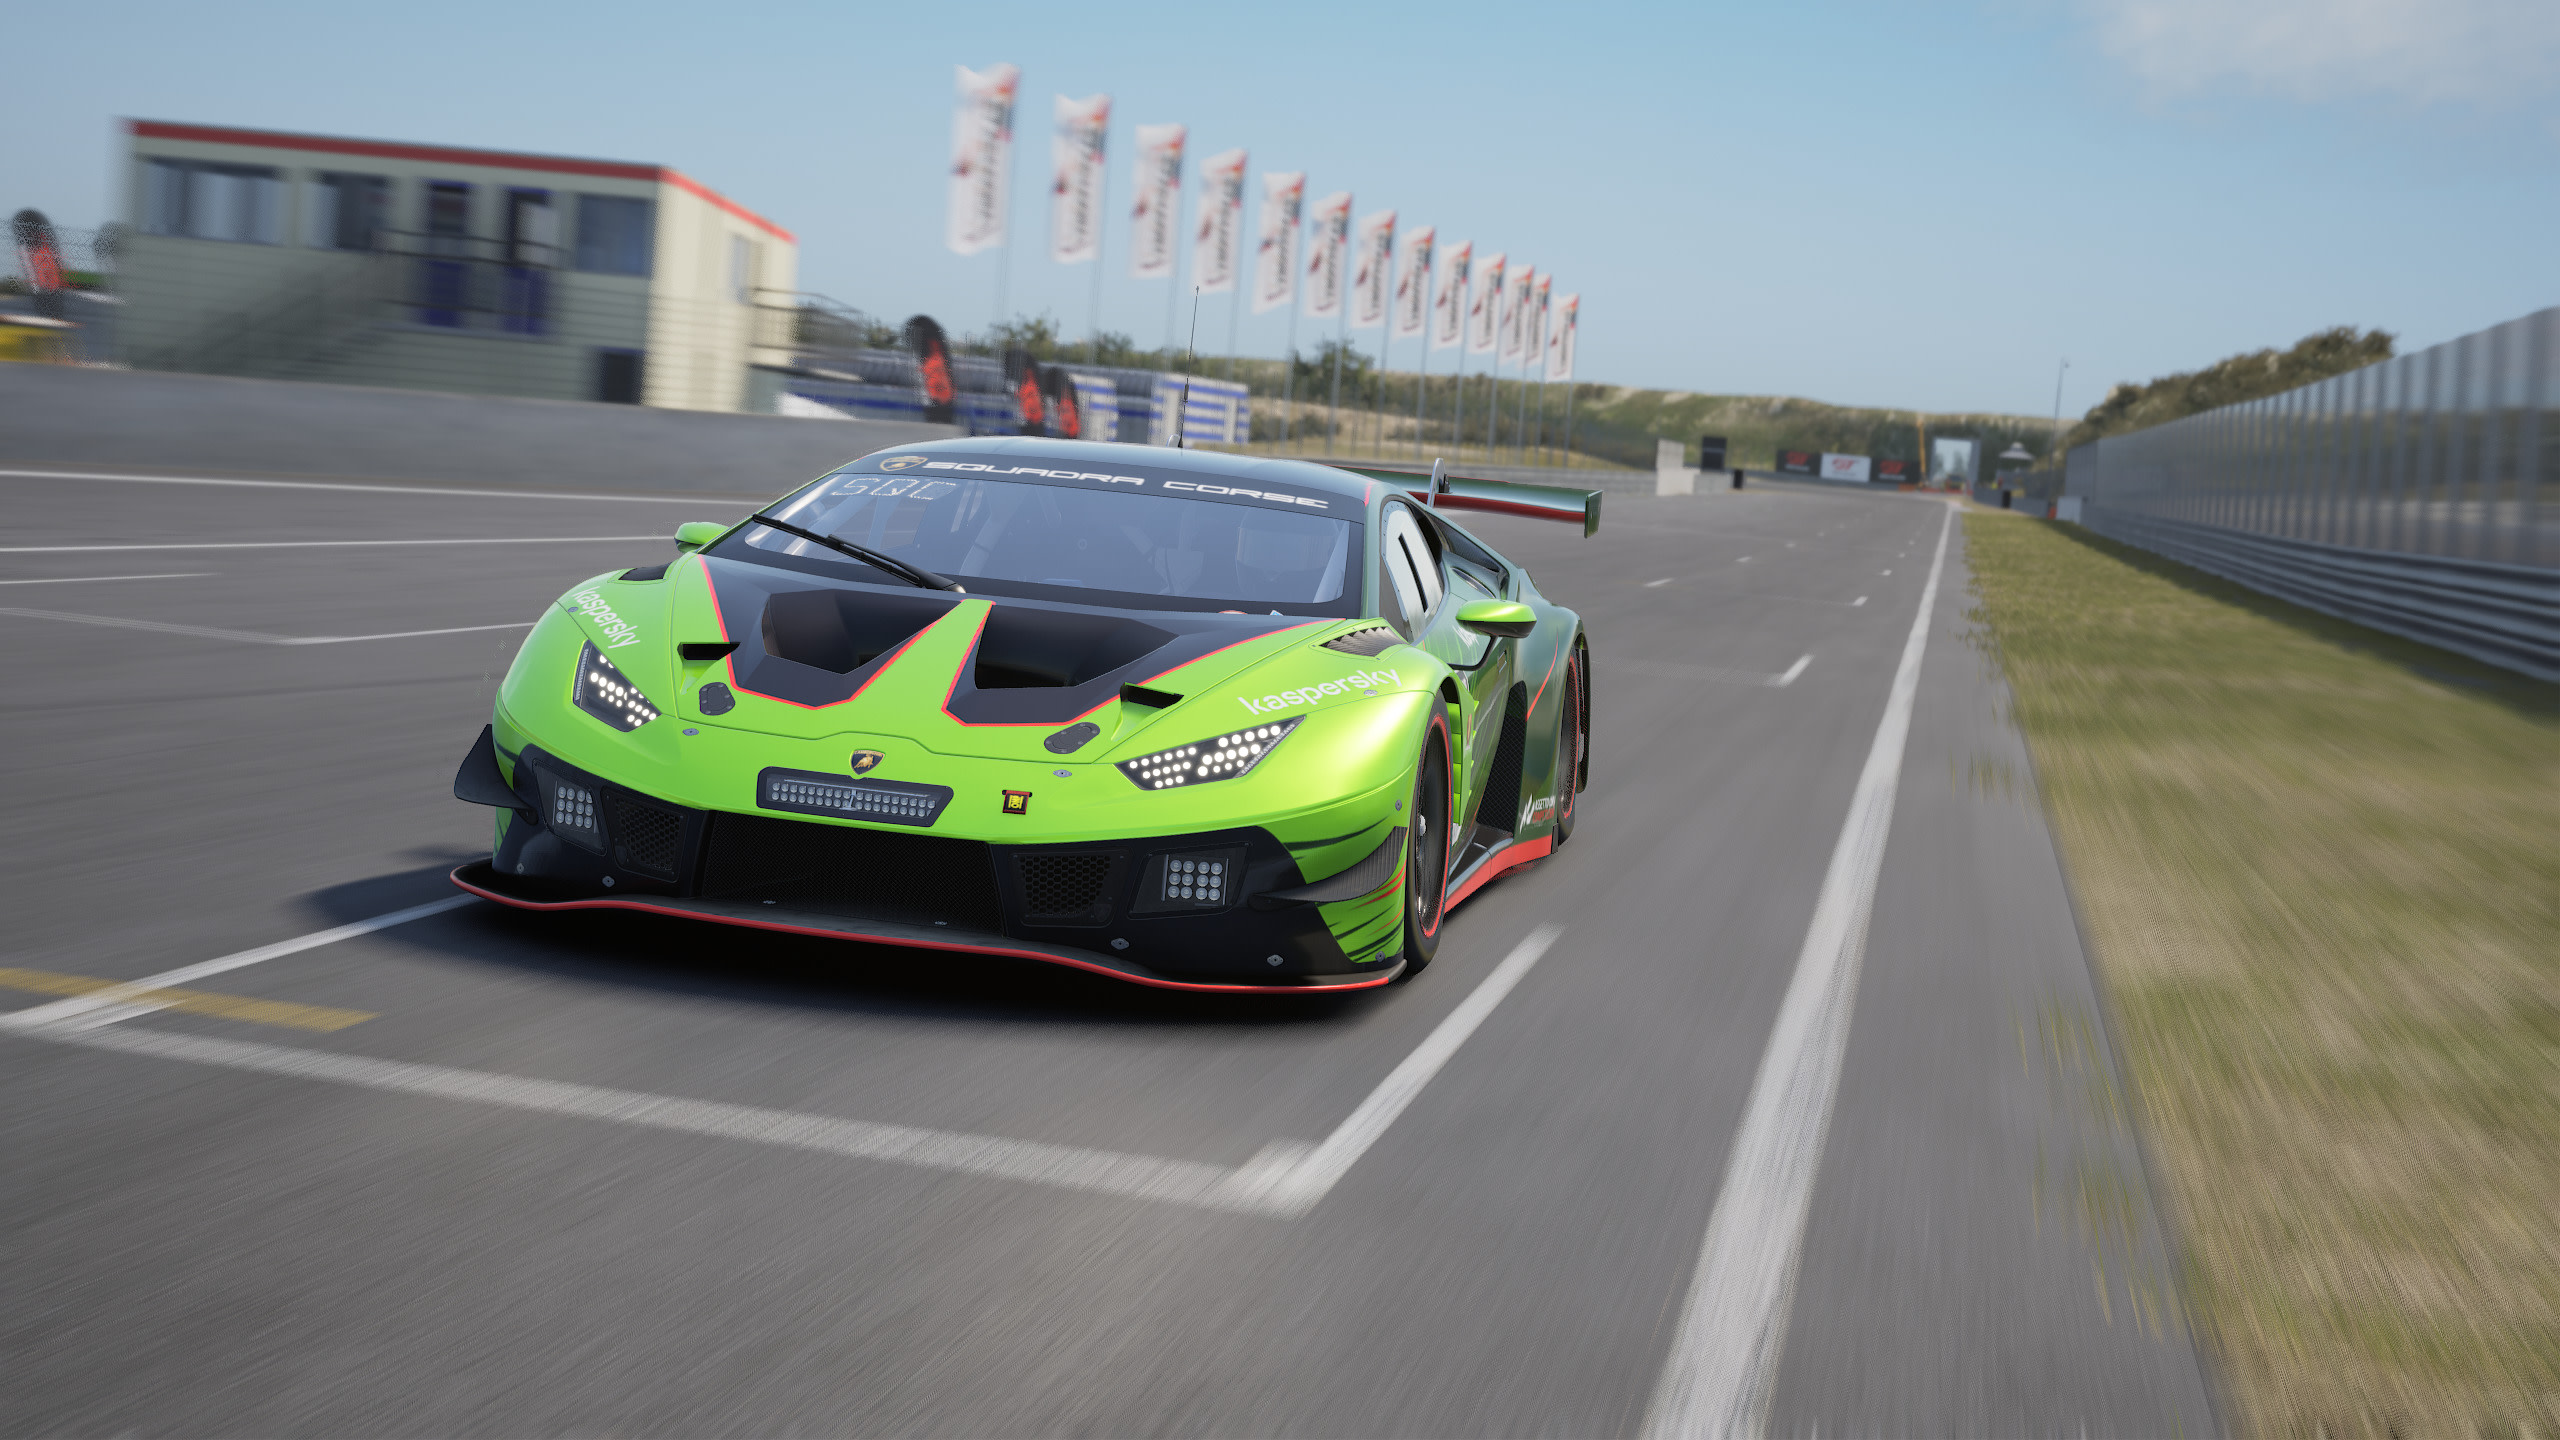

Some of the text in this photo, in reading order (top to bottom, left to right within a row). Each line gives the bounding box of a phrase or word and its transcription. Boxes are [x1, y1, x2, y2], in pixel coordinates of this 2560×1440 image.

[922, 461, 1330, 510] SQUADRA CORSE
[571, 585, 641, 649] kaspersky
[1237, 668, 1403, 716] kaspersky
